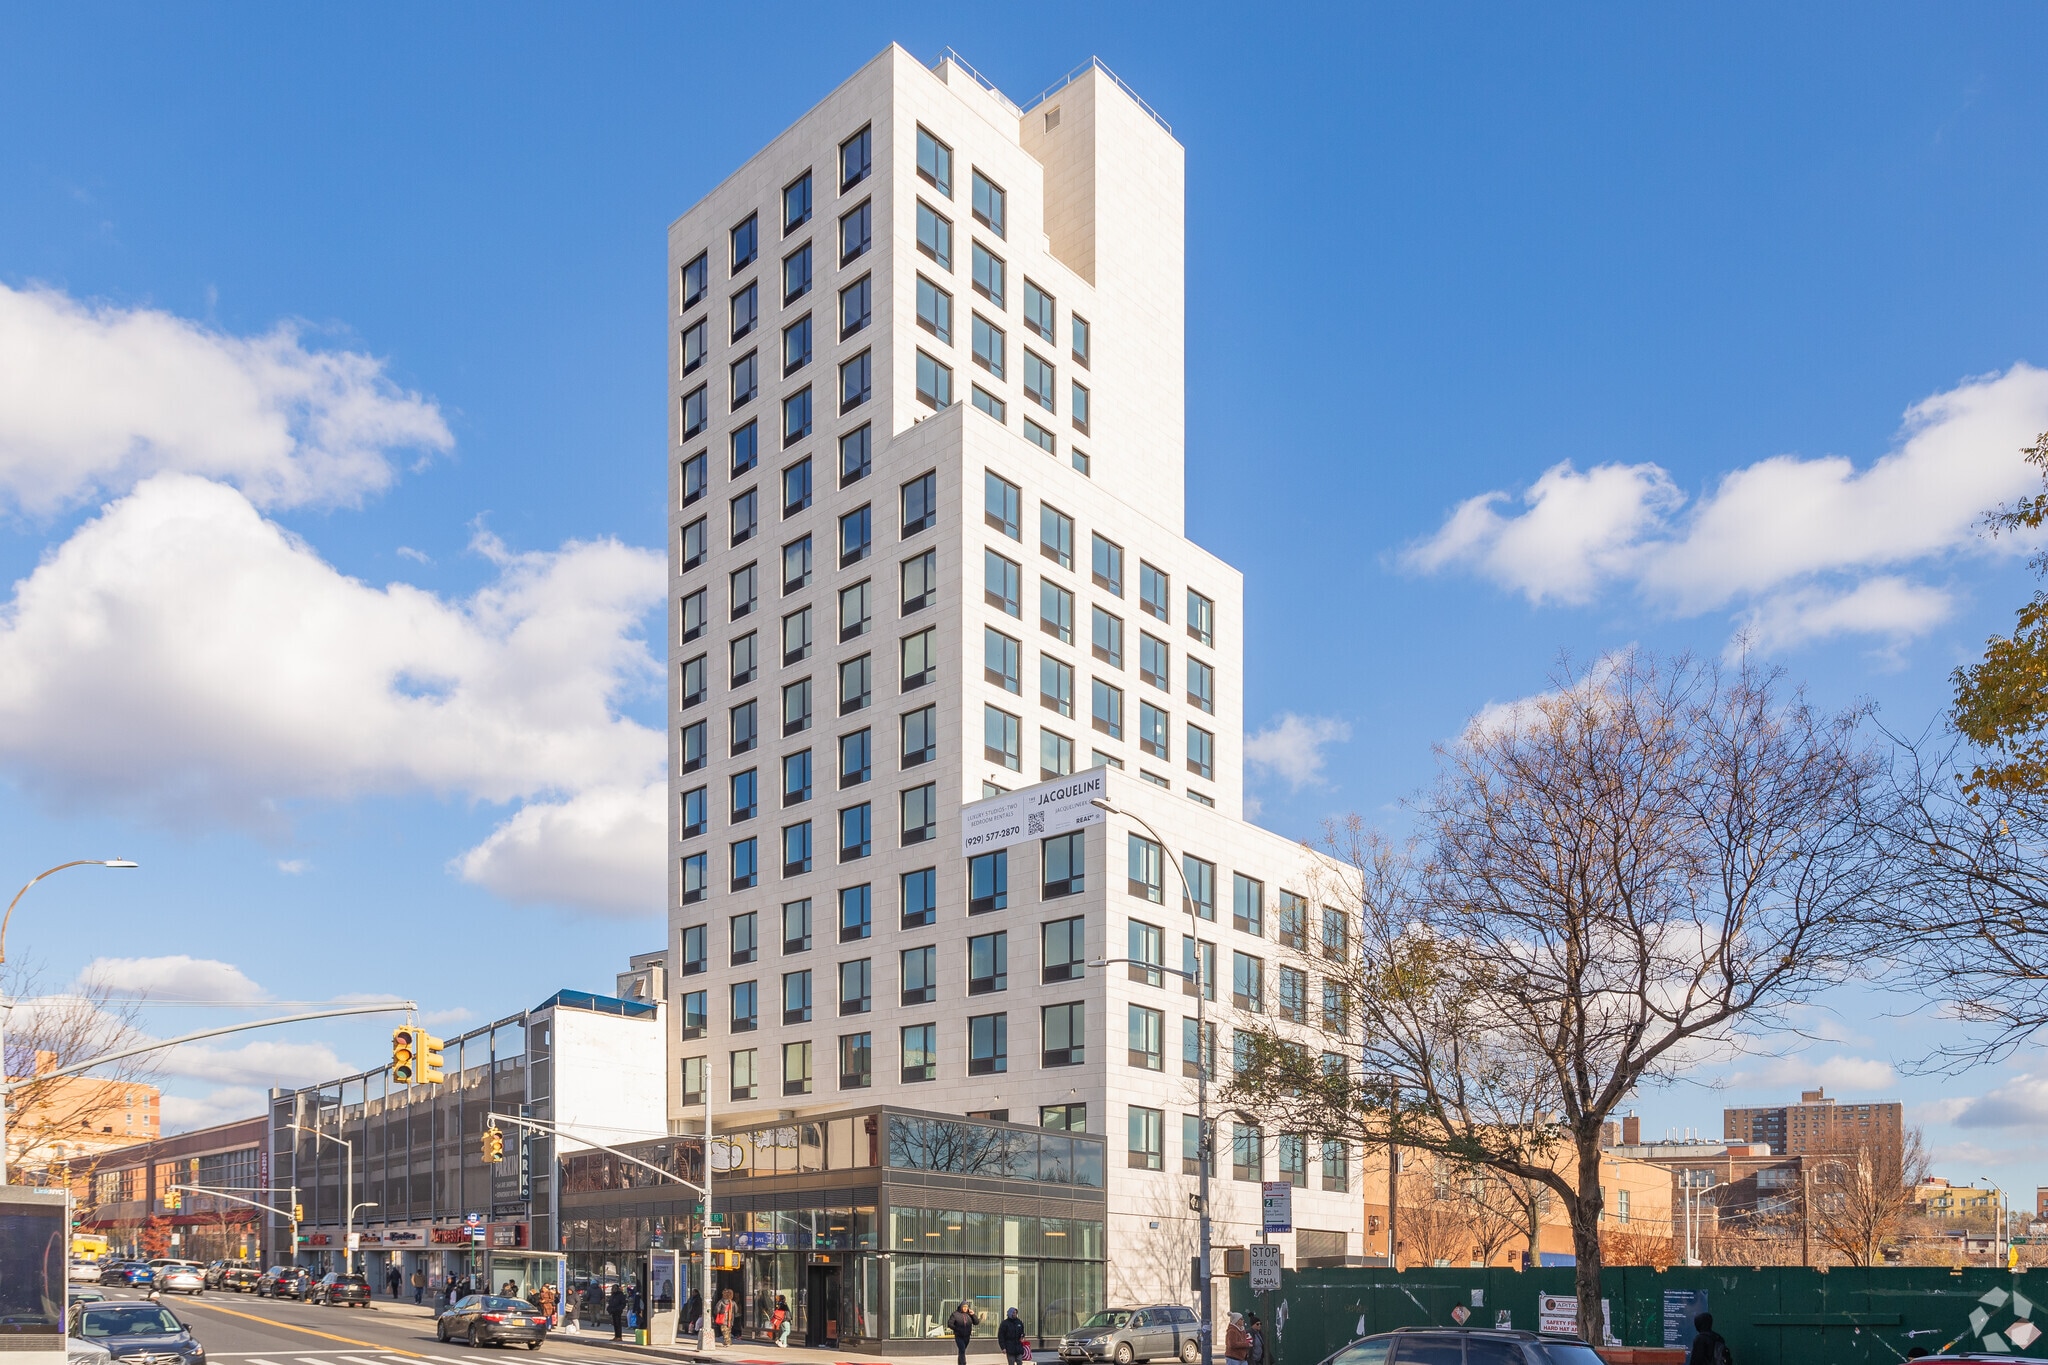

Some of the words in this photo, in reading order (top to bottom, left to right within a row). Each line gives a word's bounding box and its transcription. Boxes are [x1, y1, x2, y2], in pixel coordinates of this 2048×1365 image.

[1038, 778, 1100, 806] JACQUELINE
[967, 811, 984, 821] LUXURY
[971, 817, 993, 827] BEDROOM
[994, 811, 1014, 821] RENTALS
[965, 834, 984, 848] (929)
[985, 825, 1020, 842] 577-2870
[495, 1154, 519, 1177] PARKIN
[1252, 1247, 1278, 1258] STOP
[1252, 1259, 1267, 1267] HERE
[1270, 1259, 1278, 1267] ON
[1258, 1268, 1272, 1276] RED
[1253, 1277, 1278, 1285] SIGNAL
